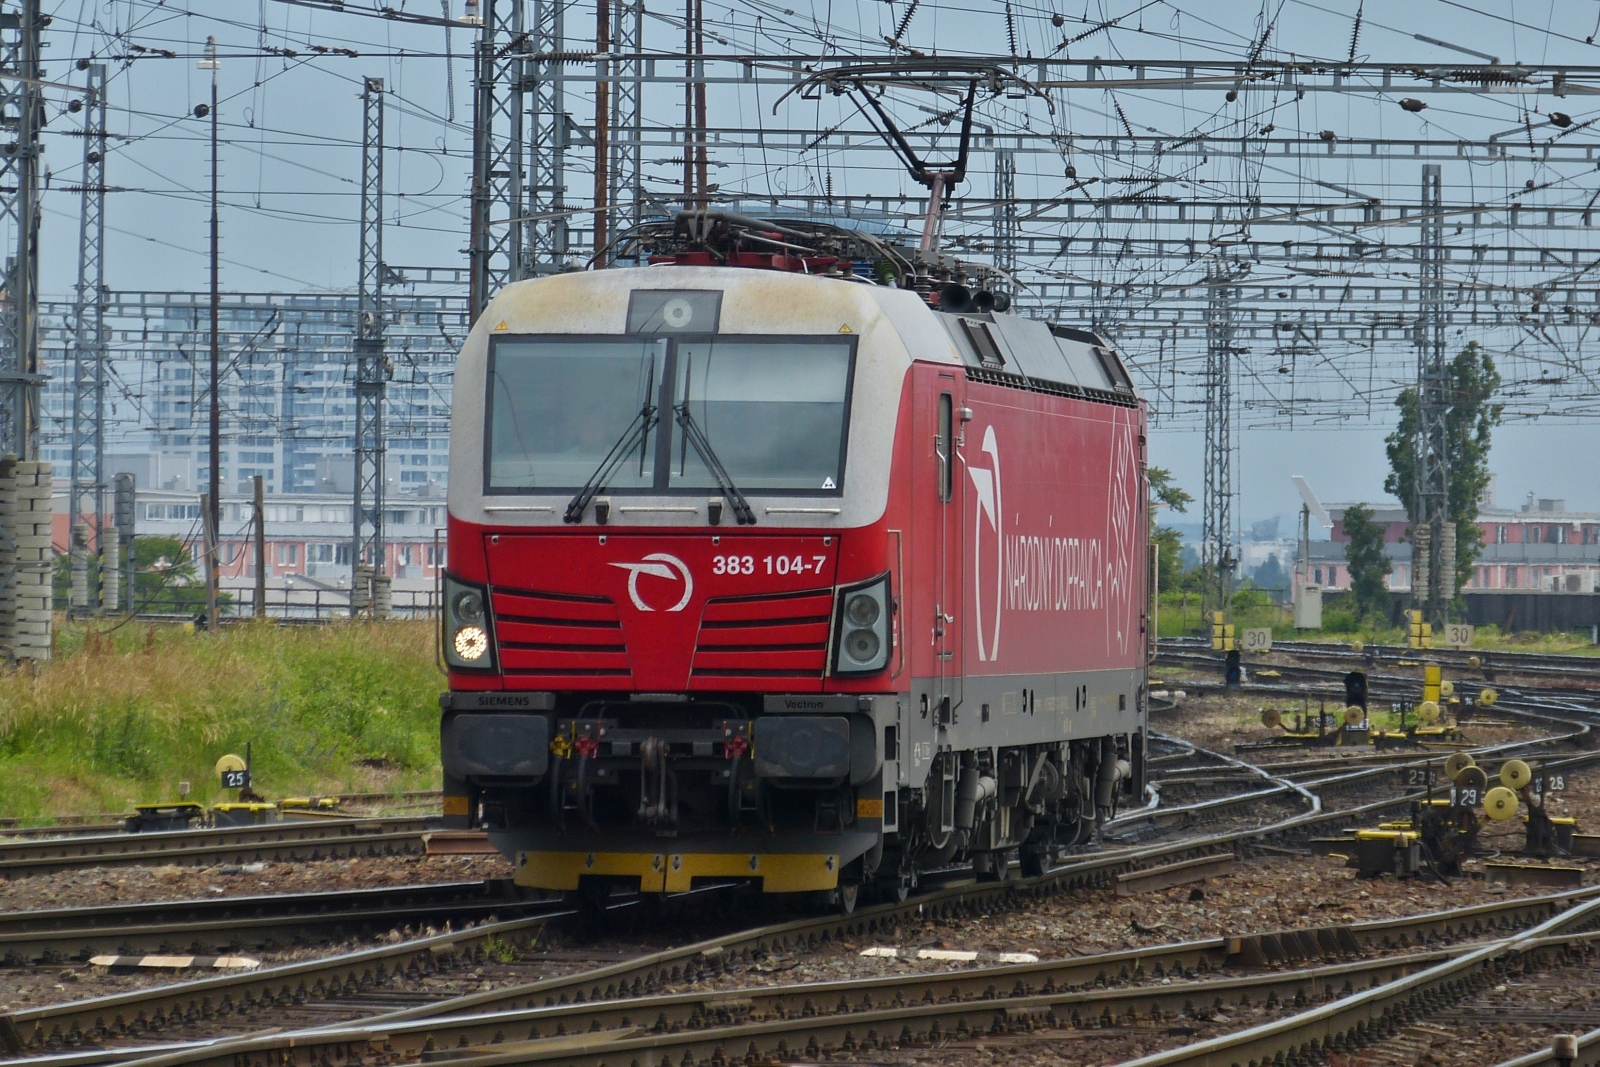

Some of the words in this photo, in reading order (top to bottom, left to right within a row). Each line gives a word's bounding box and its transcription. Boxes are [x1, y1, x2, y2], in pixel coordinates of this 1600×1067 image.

[712, 555, 755, 575] 383
[762, 555, 827, 575] 104-7
[1248, 631, 1266, 647] 30
[1451, 627, 1469, 644] 30
[478, 696, 530, 706] SIEMENS
[784, 700, 824, 709] Vectron
[226, 772, 244, 787] 25
[1409, 769, 1426, 785] 27
[1549, 776, 1565, 790] 28
[1460, 789, 1477, 806] 29
